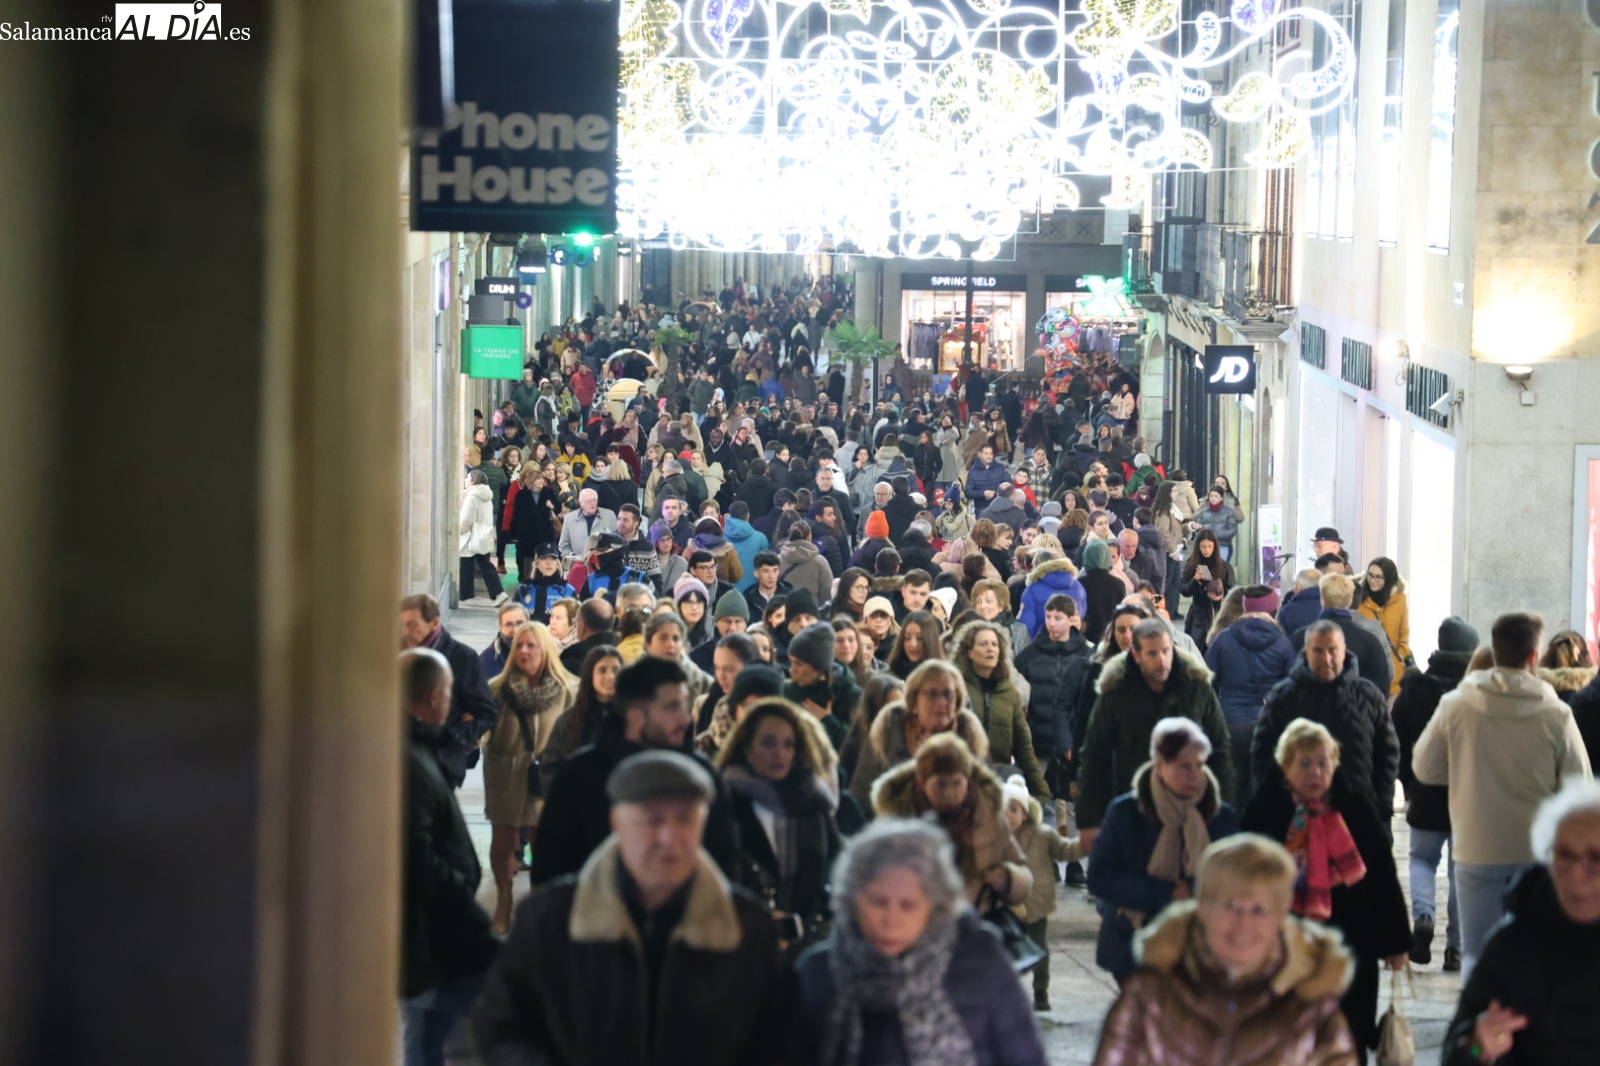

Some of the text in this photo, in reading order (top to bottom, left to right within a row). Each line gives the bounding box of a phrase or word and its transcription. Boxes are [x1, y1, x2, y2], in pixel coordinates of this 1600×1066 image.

[421, 155, 609, 205] House
[931, 276, 997, 287] SPRINGIELD
[1210, 356, 1249, 383] JD
